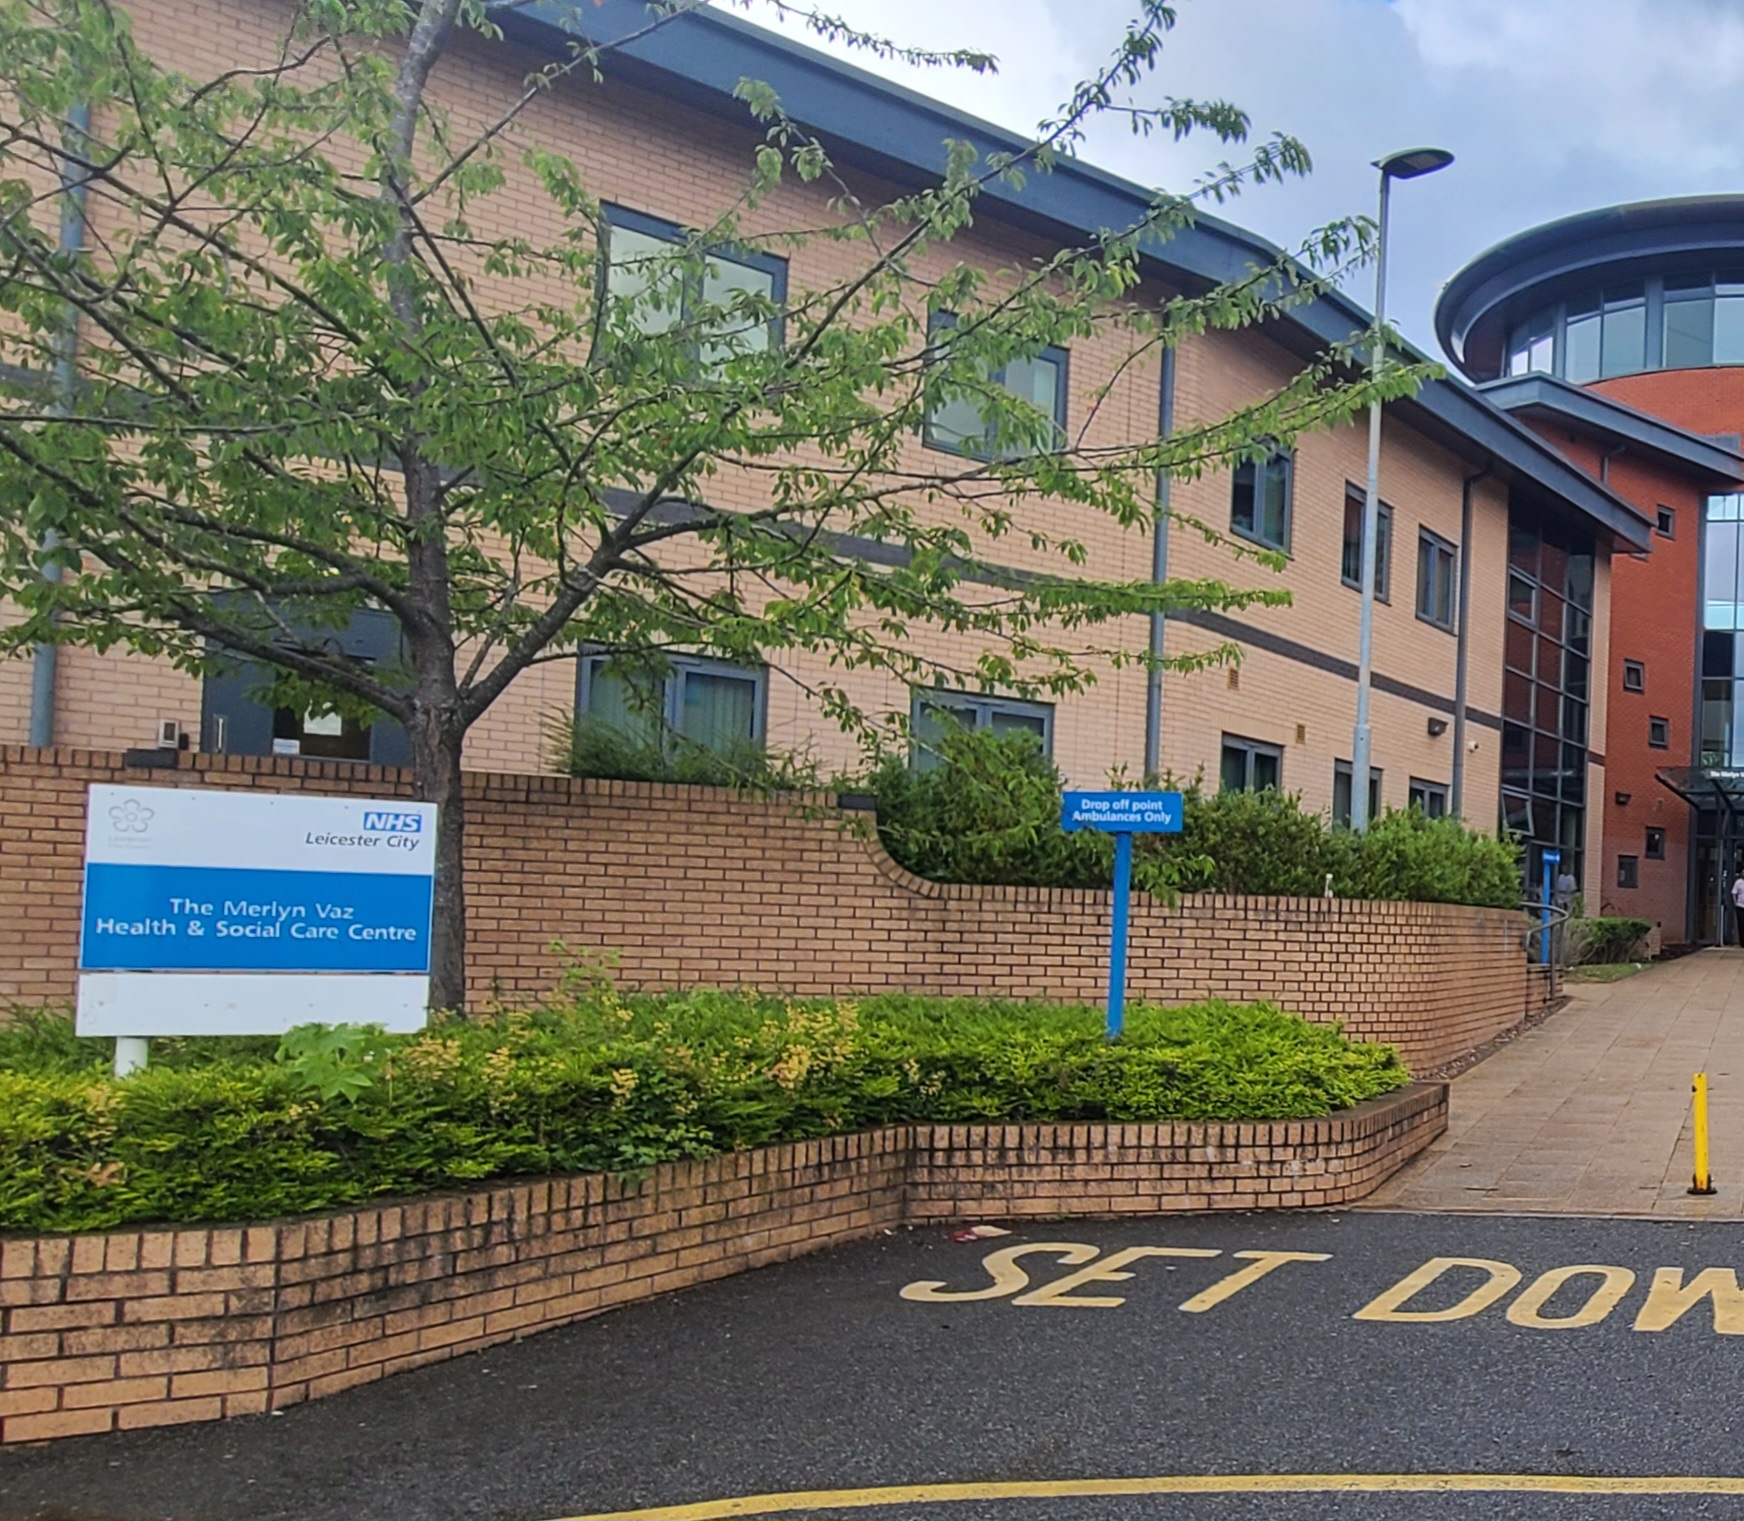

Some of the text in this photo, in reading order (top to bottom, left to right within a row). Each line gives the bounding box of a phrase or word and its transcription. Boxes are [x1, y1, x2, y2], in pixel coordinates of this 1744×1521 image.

[1081, 798, 1163, 812] Drop off point
[365, 813, 420, 832] NHS
[1072, 810, 1172, 825] Ambulances Only
[305, 831, 420, 851] Leicester City
[169, 897, 355, 922] The Merlyn Vaz
[95, 918, 417, 941] Health & Social Care Centre
[903, 1243, 1332, 1314] SET
